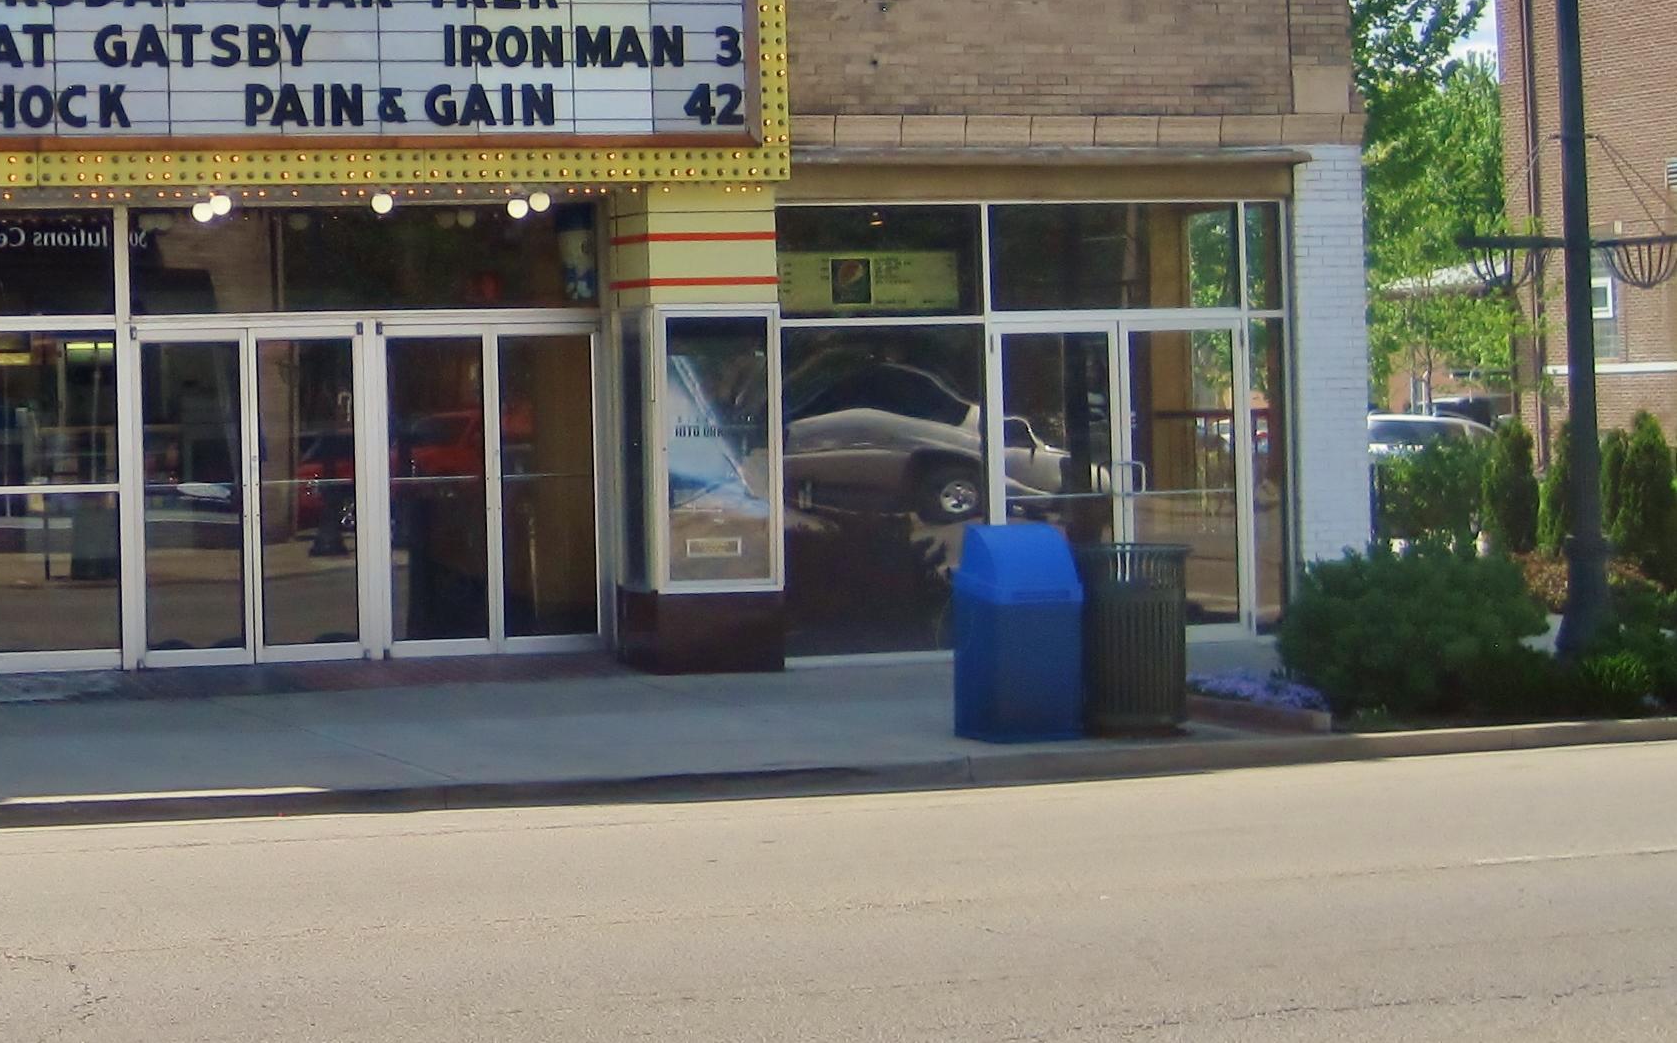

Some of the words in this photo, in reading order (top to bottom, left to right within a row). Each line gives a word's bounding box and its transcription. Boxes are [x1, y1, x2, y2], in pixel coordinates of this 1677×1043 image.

[93, 23, 311, 69] GATSBY
[715, 25, 743, 68] 3
[244, 83, 364, 128] PAIN
[377, 87, 407, 124] &
[424, 83, 555, 127] GAIN
[683, 83, 745, 126] 42
